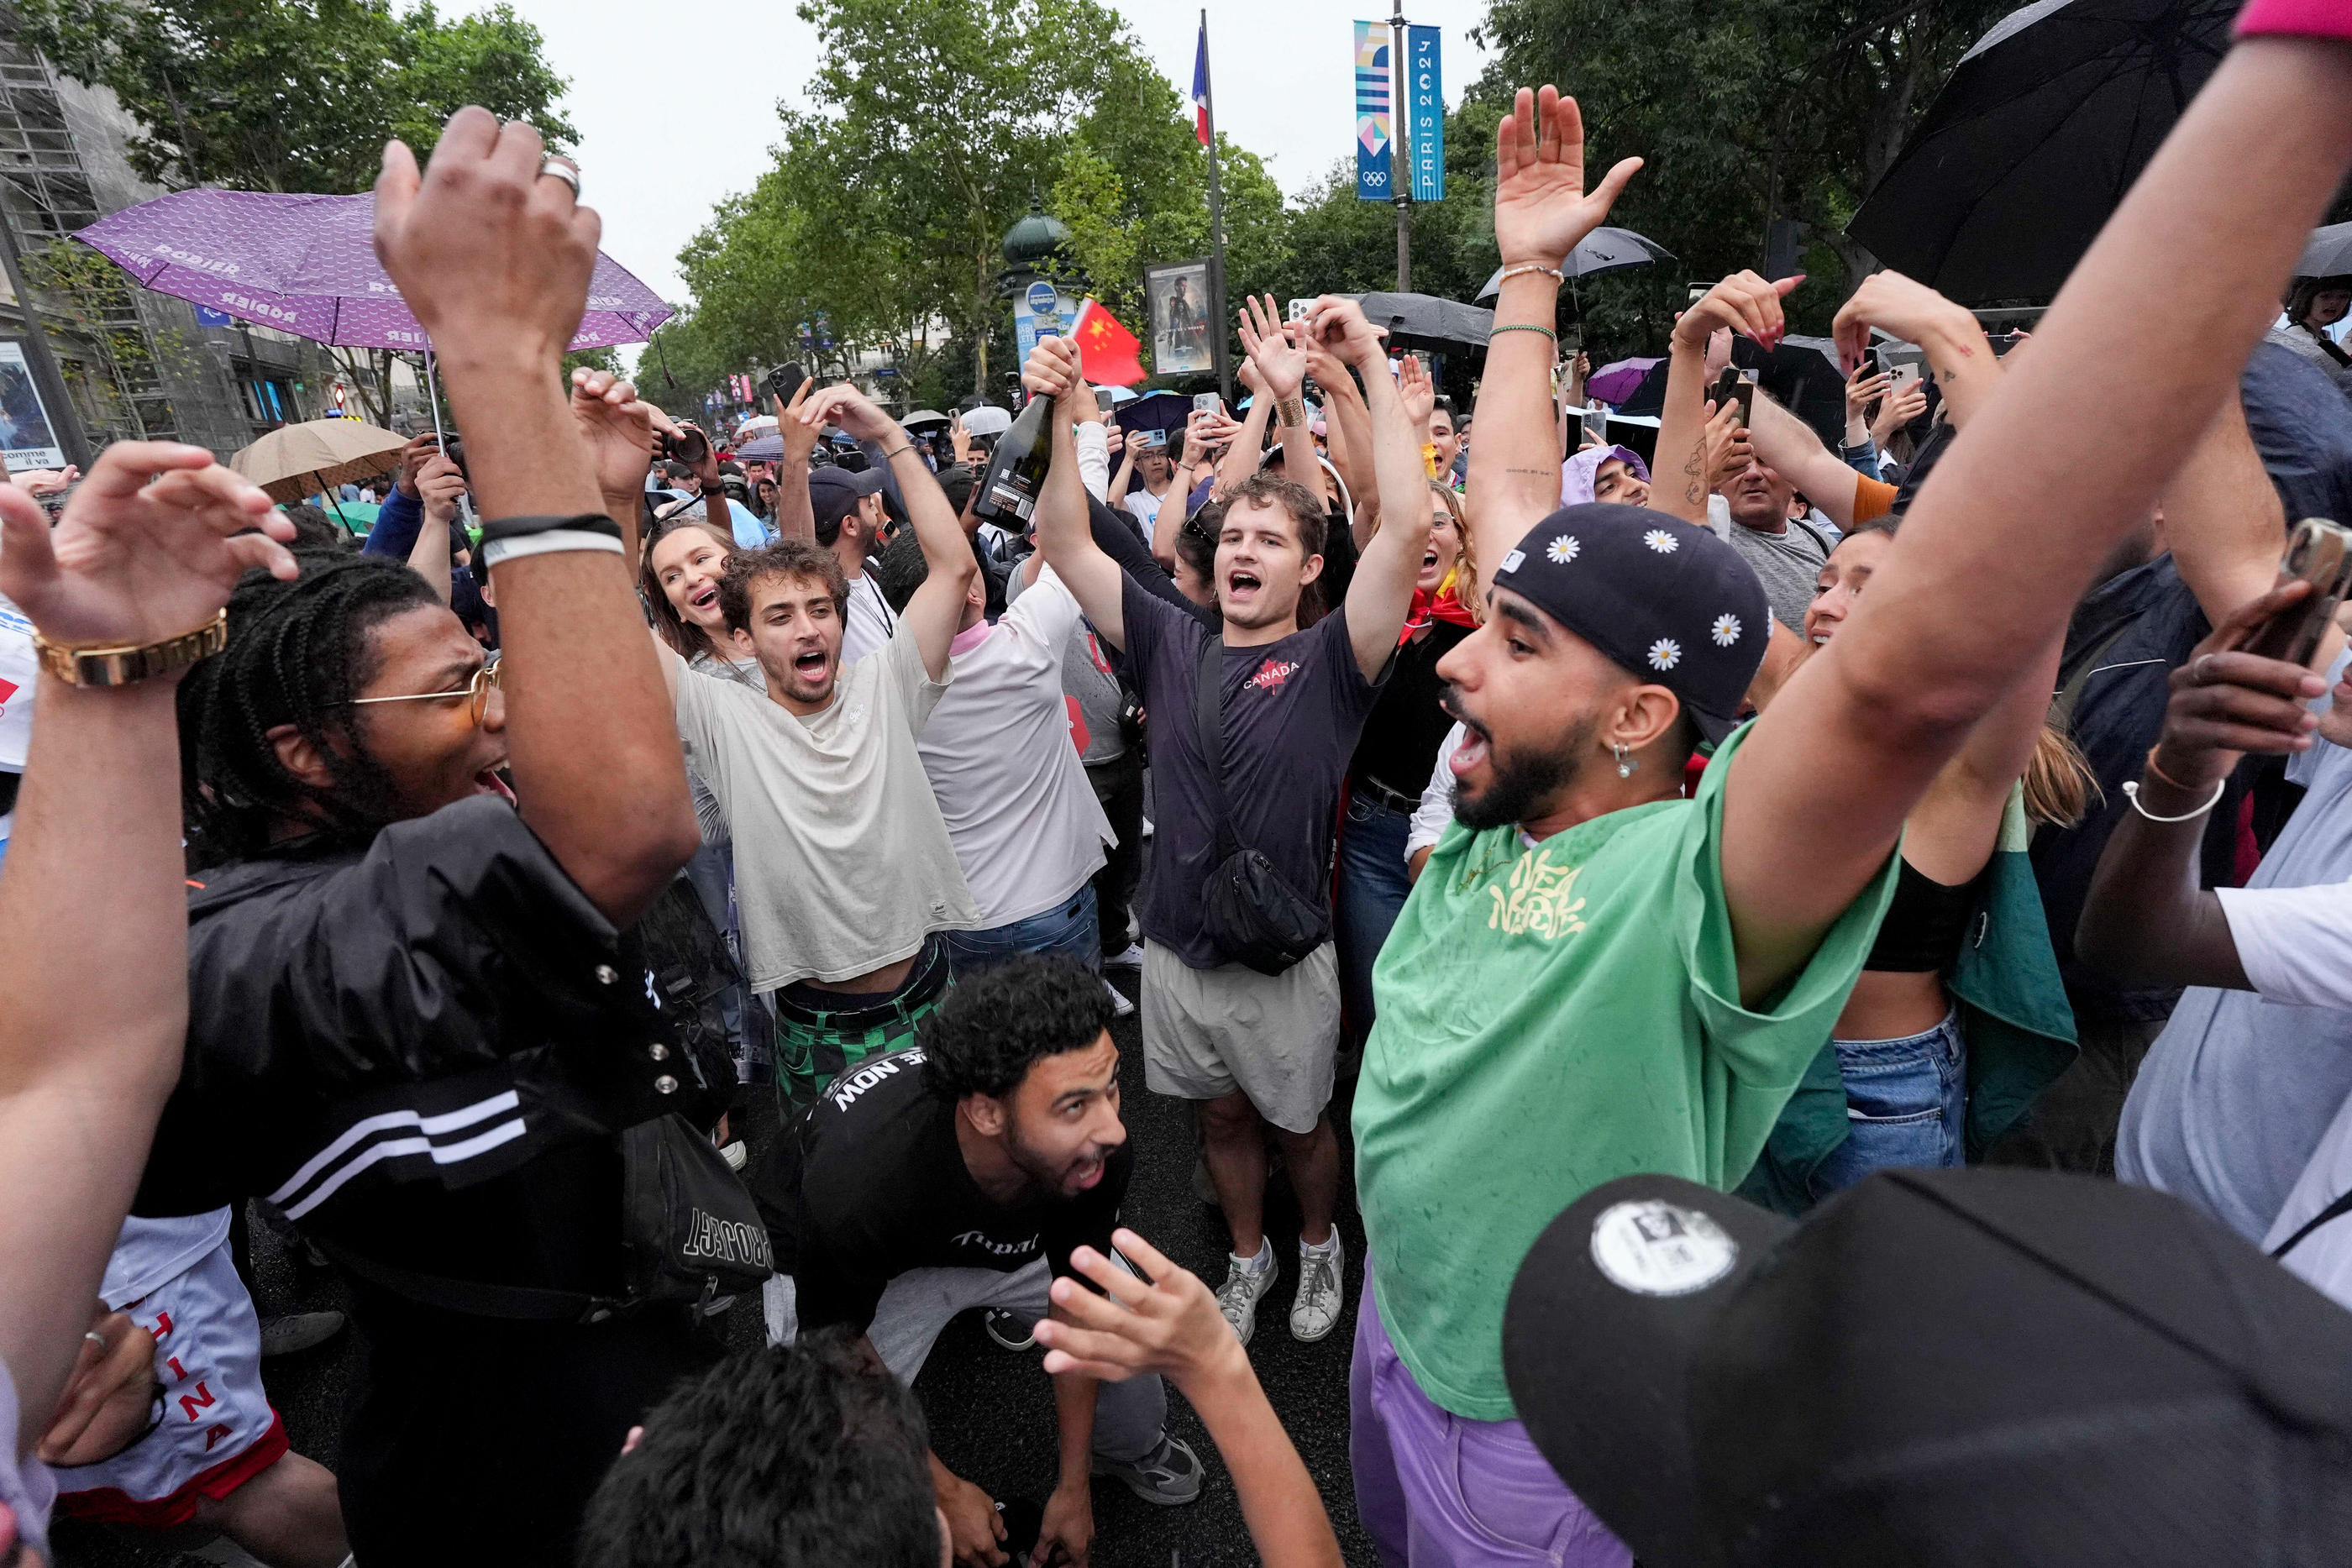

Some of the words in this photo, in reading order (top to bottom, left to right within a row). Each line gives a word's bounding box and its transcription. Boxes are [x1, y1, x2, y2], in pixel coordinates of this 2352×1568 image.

[1419, 40, 1431, 106] 2024
[152, 244, 241, 275] RODIER
[1243, 662, 1299, 689] CANADA
[834, 1061, 900, 1113] NOW
[684, 1208, 774, 1270] PROJECT
[124, 1298, 233, 1453] HINA
